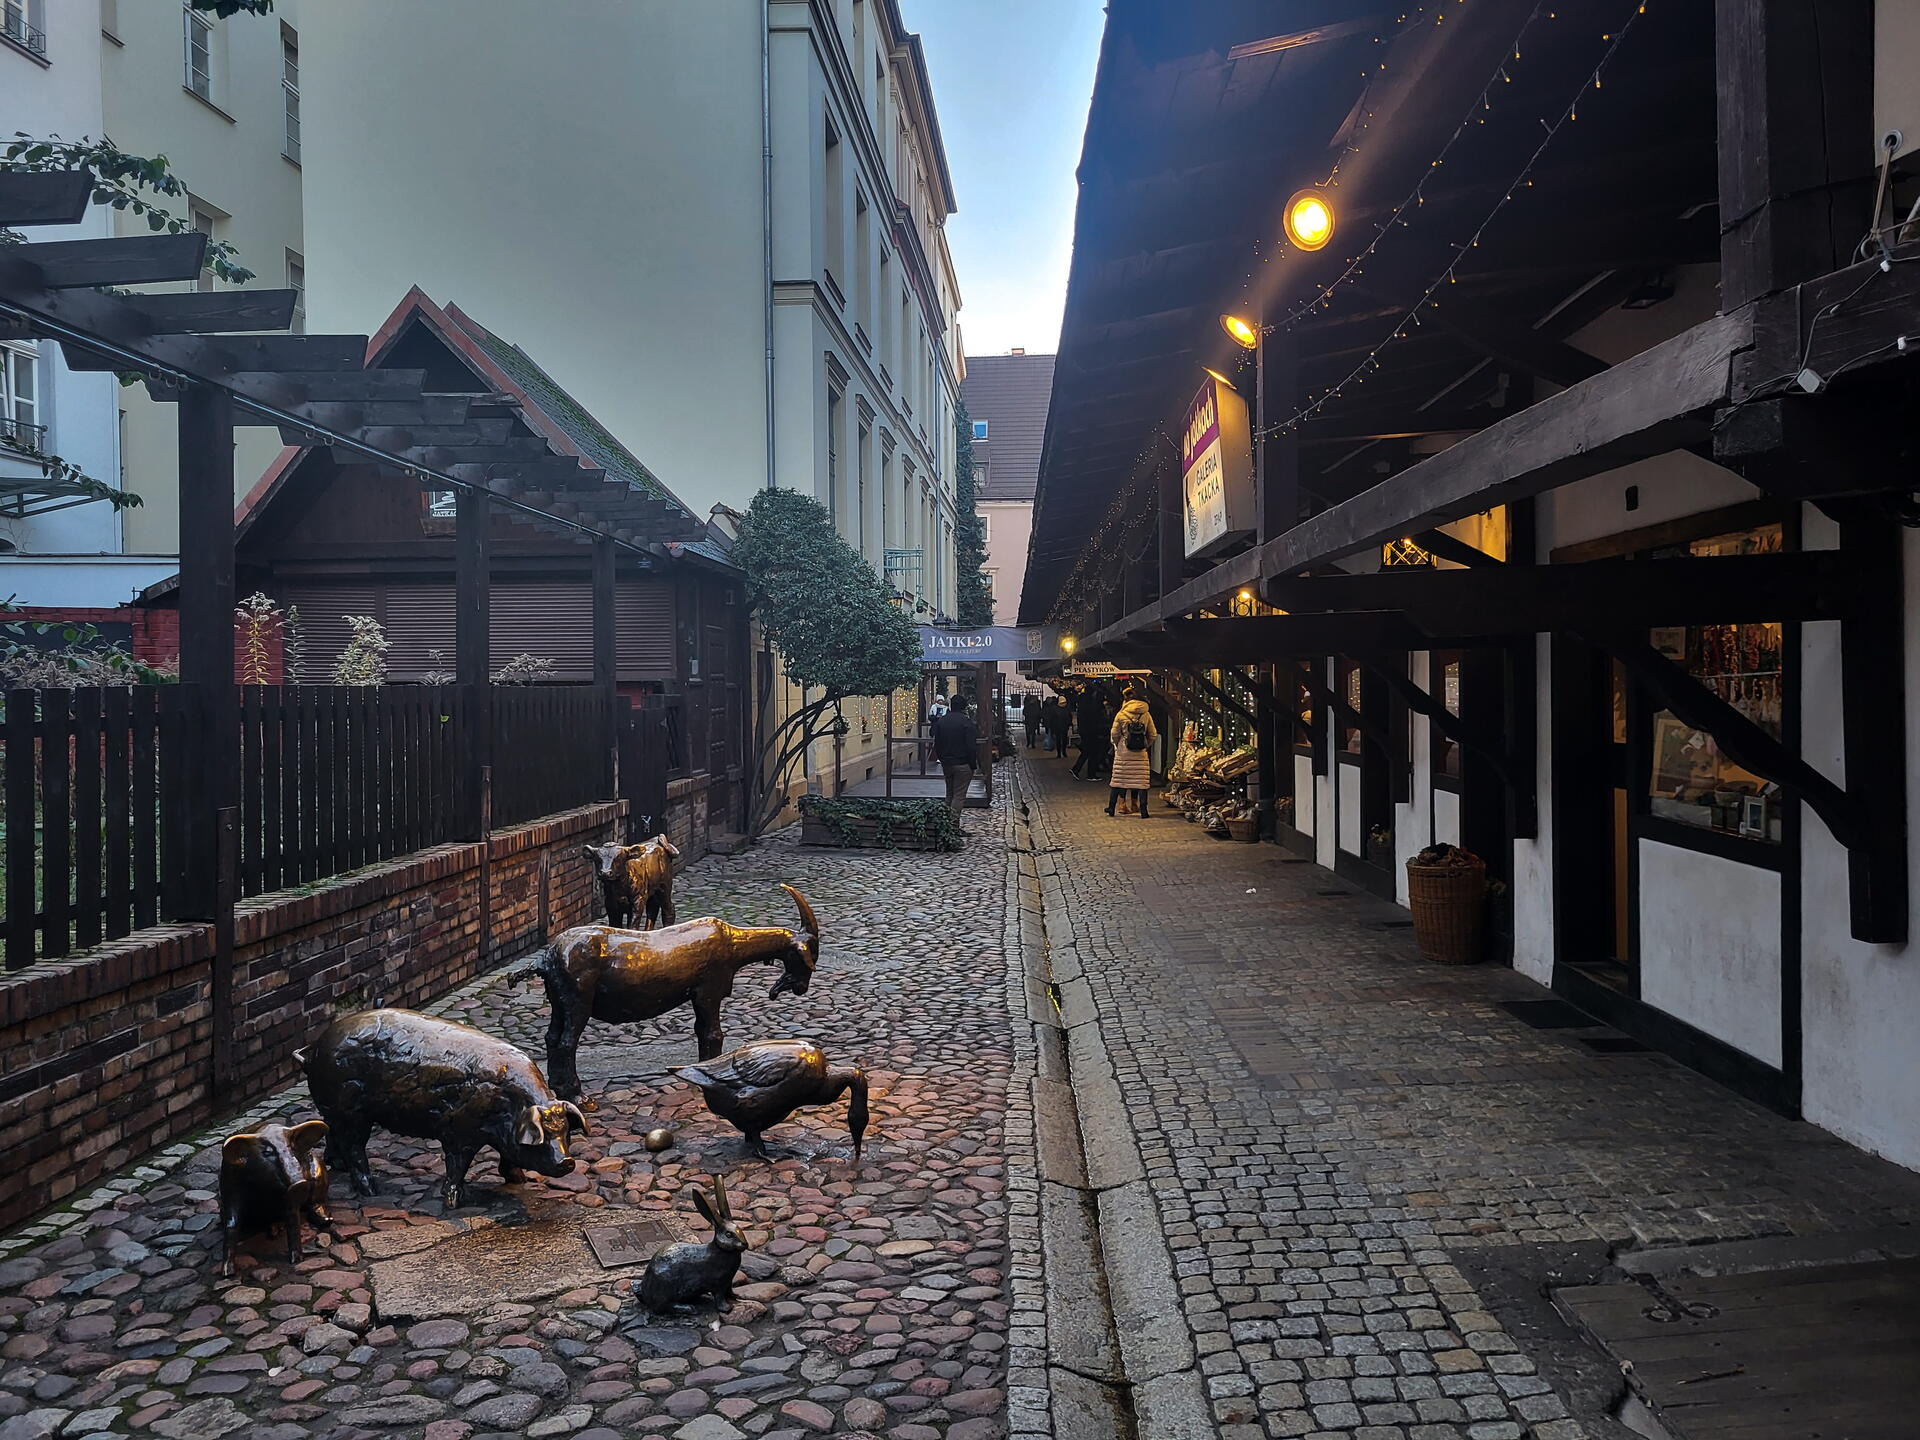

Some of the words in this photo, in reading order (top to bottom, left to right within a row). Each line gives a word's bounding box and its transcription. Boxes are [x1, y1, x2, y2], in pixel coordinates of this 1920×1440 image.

[1196, 454, 1217, 486] GALERIA
[1197, 475, 1220, 508] TKACKA
[928, 635, 971, 648] JATKI
[975, 635, 992, 647] 2.0
